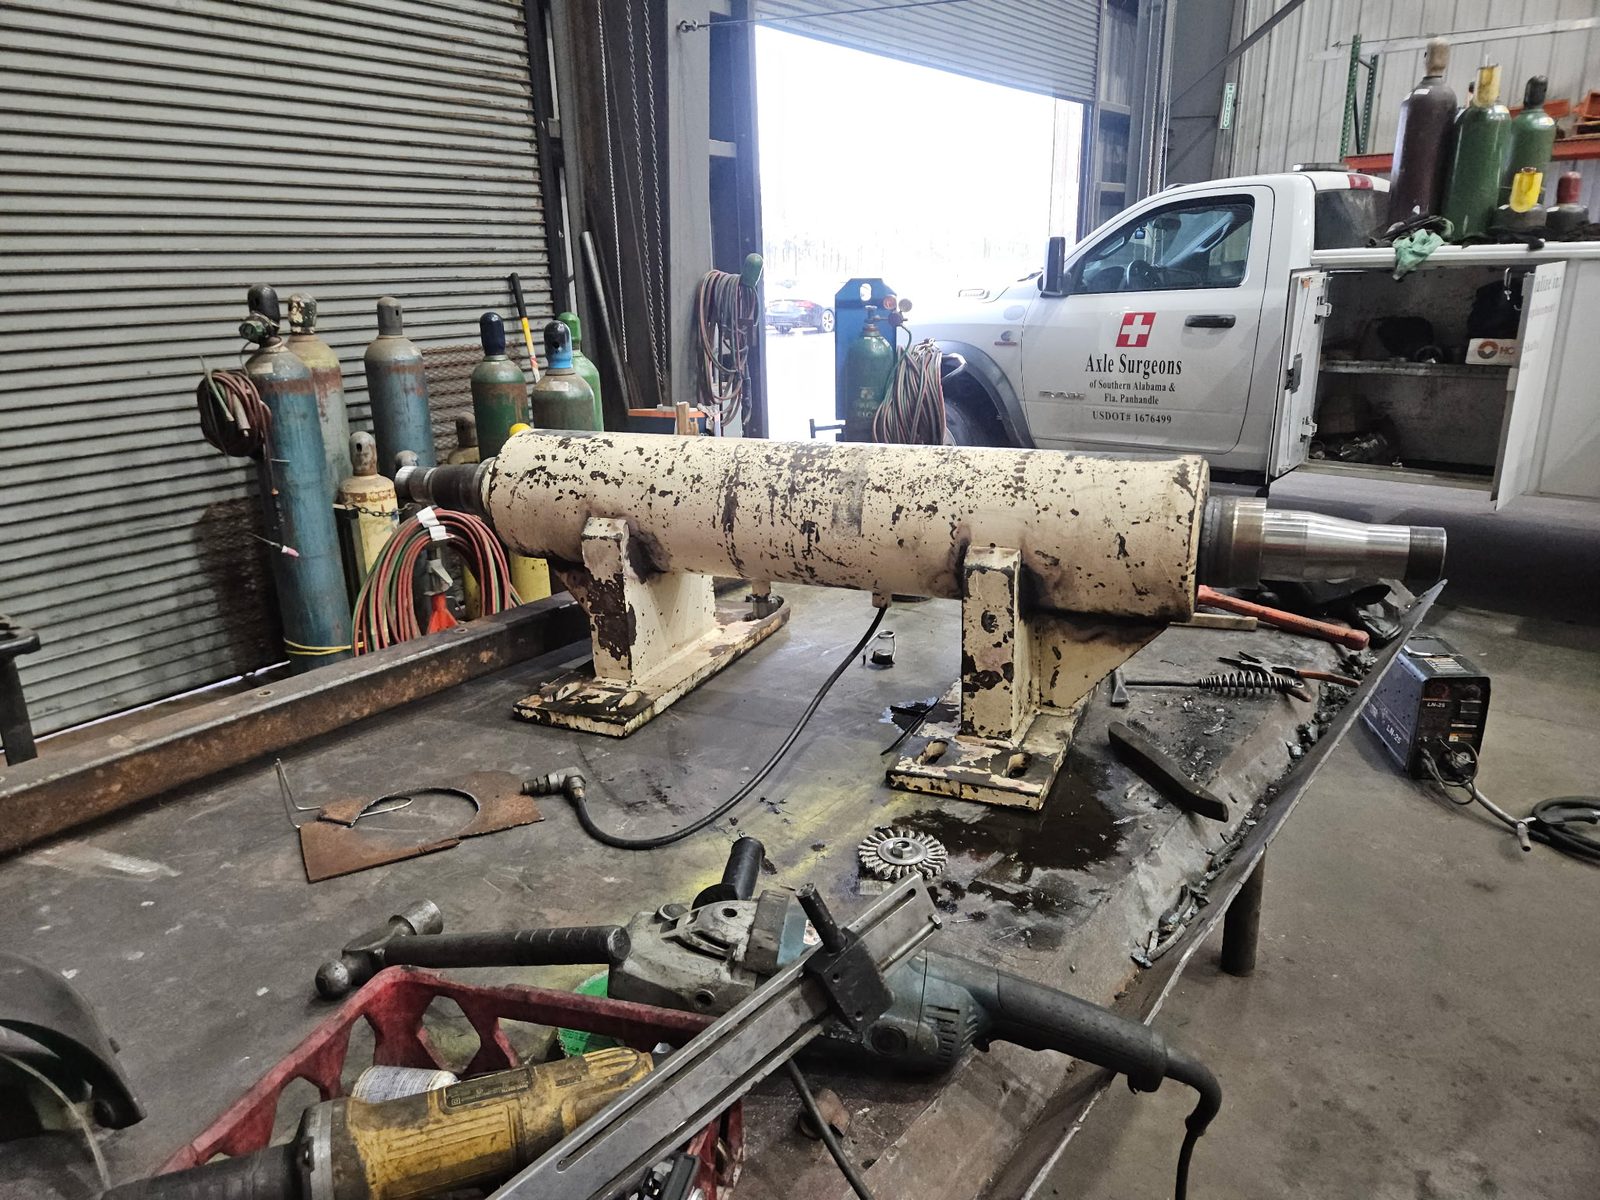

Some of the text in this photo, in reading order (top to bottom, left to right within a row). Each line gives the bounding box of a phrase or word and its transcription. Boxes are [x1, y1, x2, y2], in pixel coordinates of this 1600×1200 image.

[1085, 353, 1182, 379] Axle Surgeons
[1089, 379, 1176, 392] of Southern Alabama &
[1104, 394, 1159, 405] Fla. Panhandle
[1092, 410, 1172, 424] USDOT# 1676499
[1386, 724, 1402, 744] LN-25
